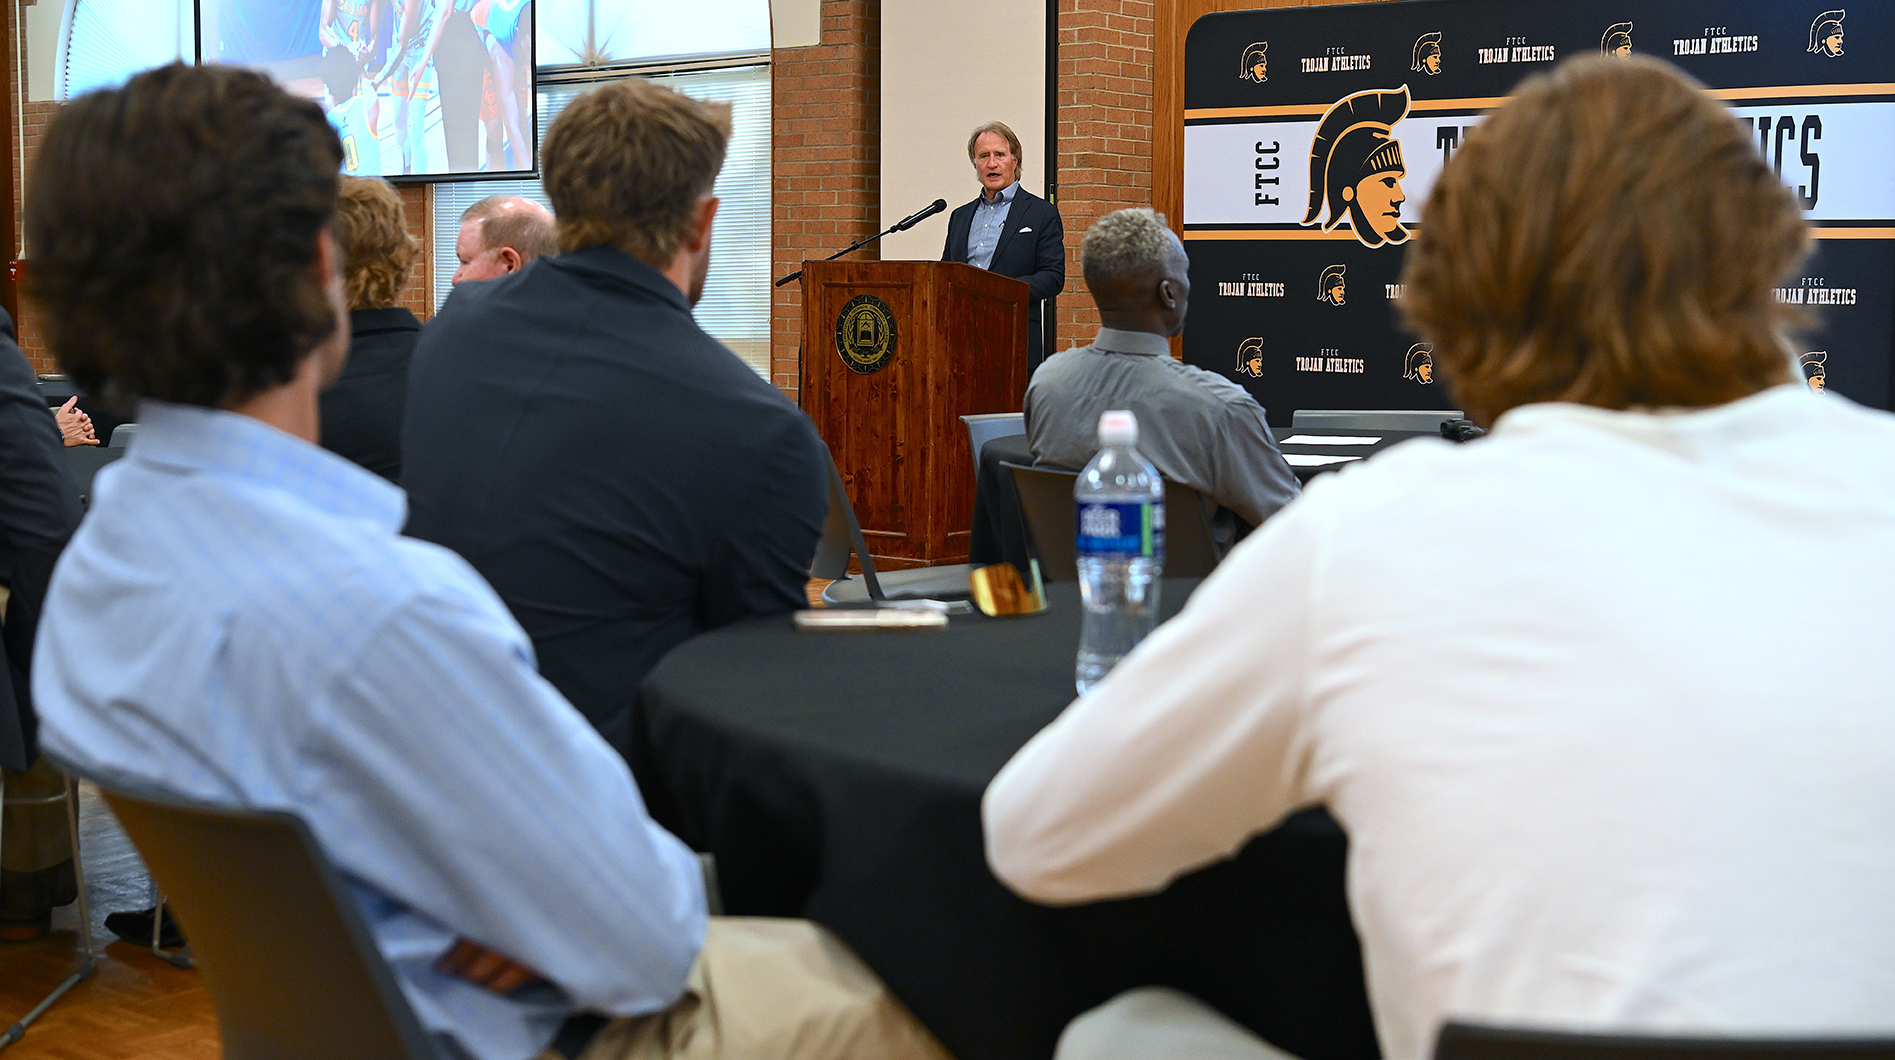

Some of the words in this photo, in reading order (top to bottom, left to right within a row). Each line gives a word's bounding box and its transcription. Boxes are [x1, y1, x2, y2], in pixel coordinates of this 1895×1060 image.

[348, 21, 359, 42] 4
[1704, 26, 1726, 36] FTCC
[1506, 36, 1526, 45] FTCC
[1673, 38, 1707, 55] TROJAN
[1709, 35, 1758, 54] ATHLETICS
[1326, 46, 1345, 55] FTCC
[1478, 47, 1509, 64] TROJAN
[1511, 45, 1555, 62] ATHLETICS
[1301, 57, 1329, 73] TROJAN
[1331, 54, 1371, 72] ATHLETICS
[1255, 140, 1280, 206] FTCC
[1242, 273, 1260, 281] FTCC
[1801, 277, 1824, 286] FTCC
[1218, 282, 1245, 296] TROJAN
[1247, 282, 1284, 297] ATHLETICS
[1806, 288, 1857, 305] ATHLETICS
[1320, 348, 1339, 356] FTCC
[1296, 356, 1323, 372] TROJAN
[1325, 357, 1364, 374] ATHLETICS
